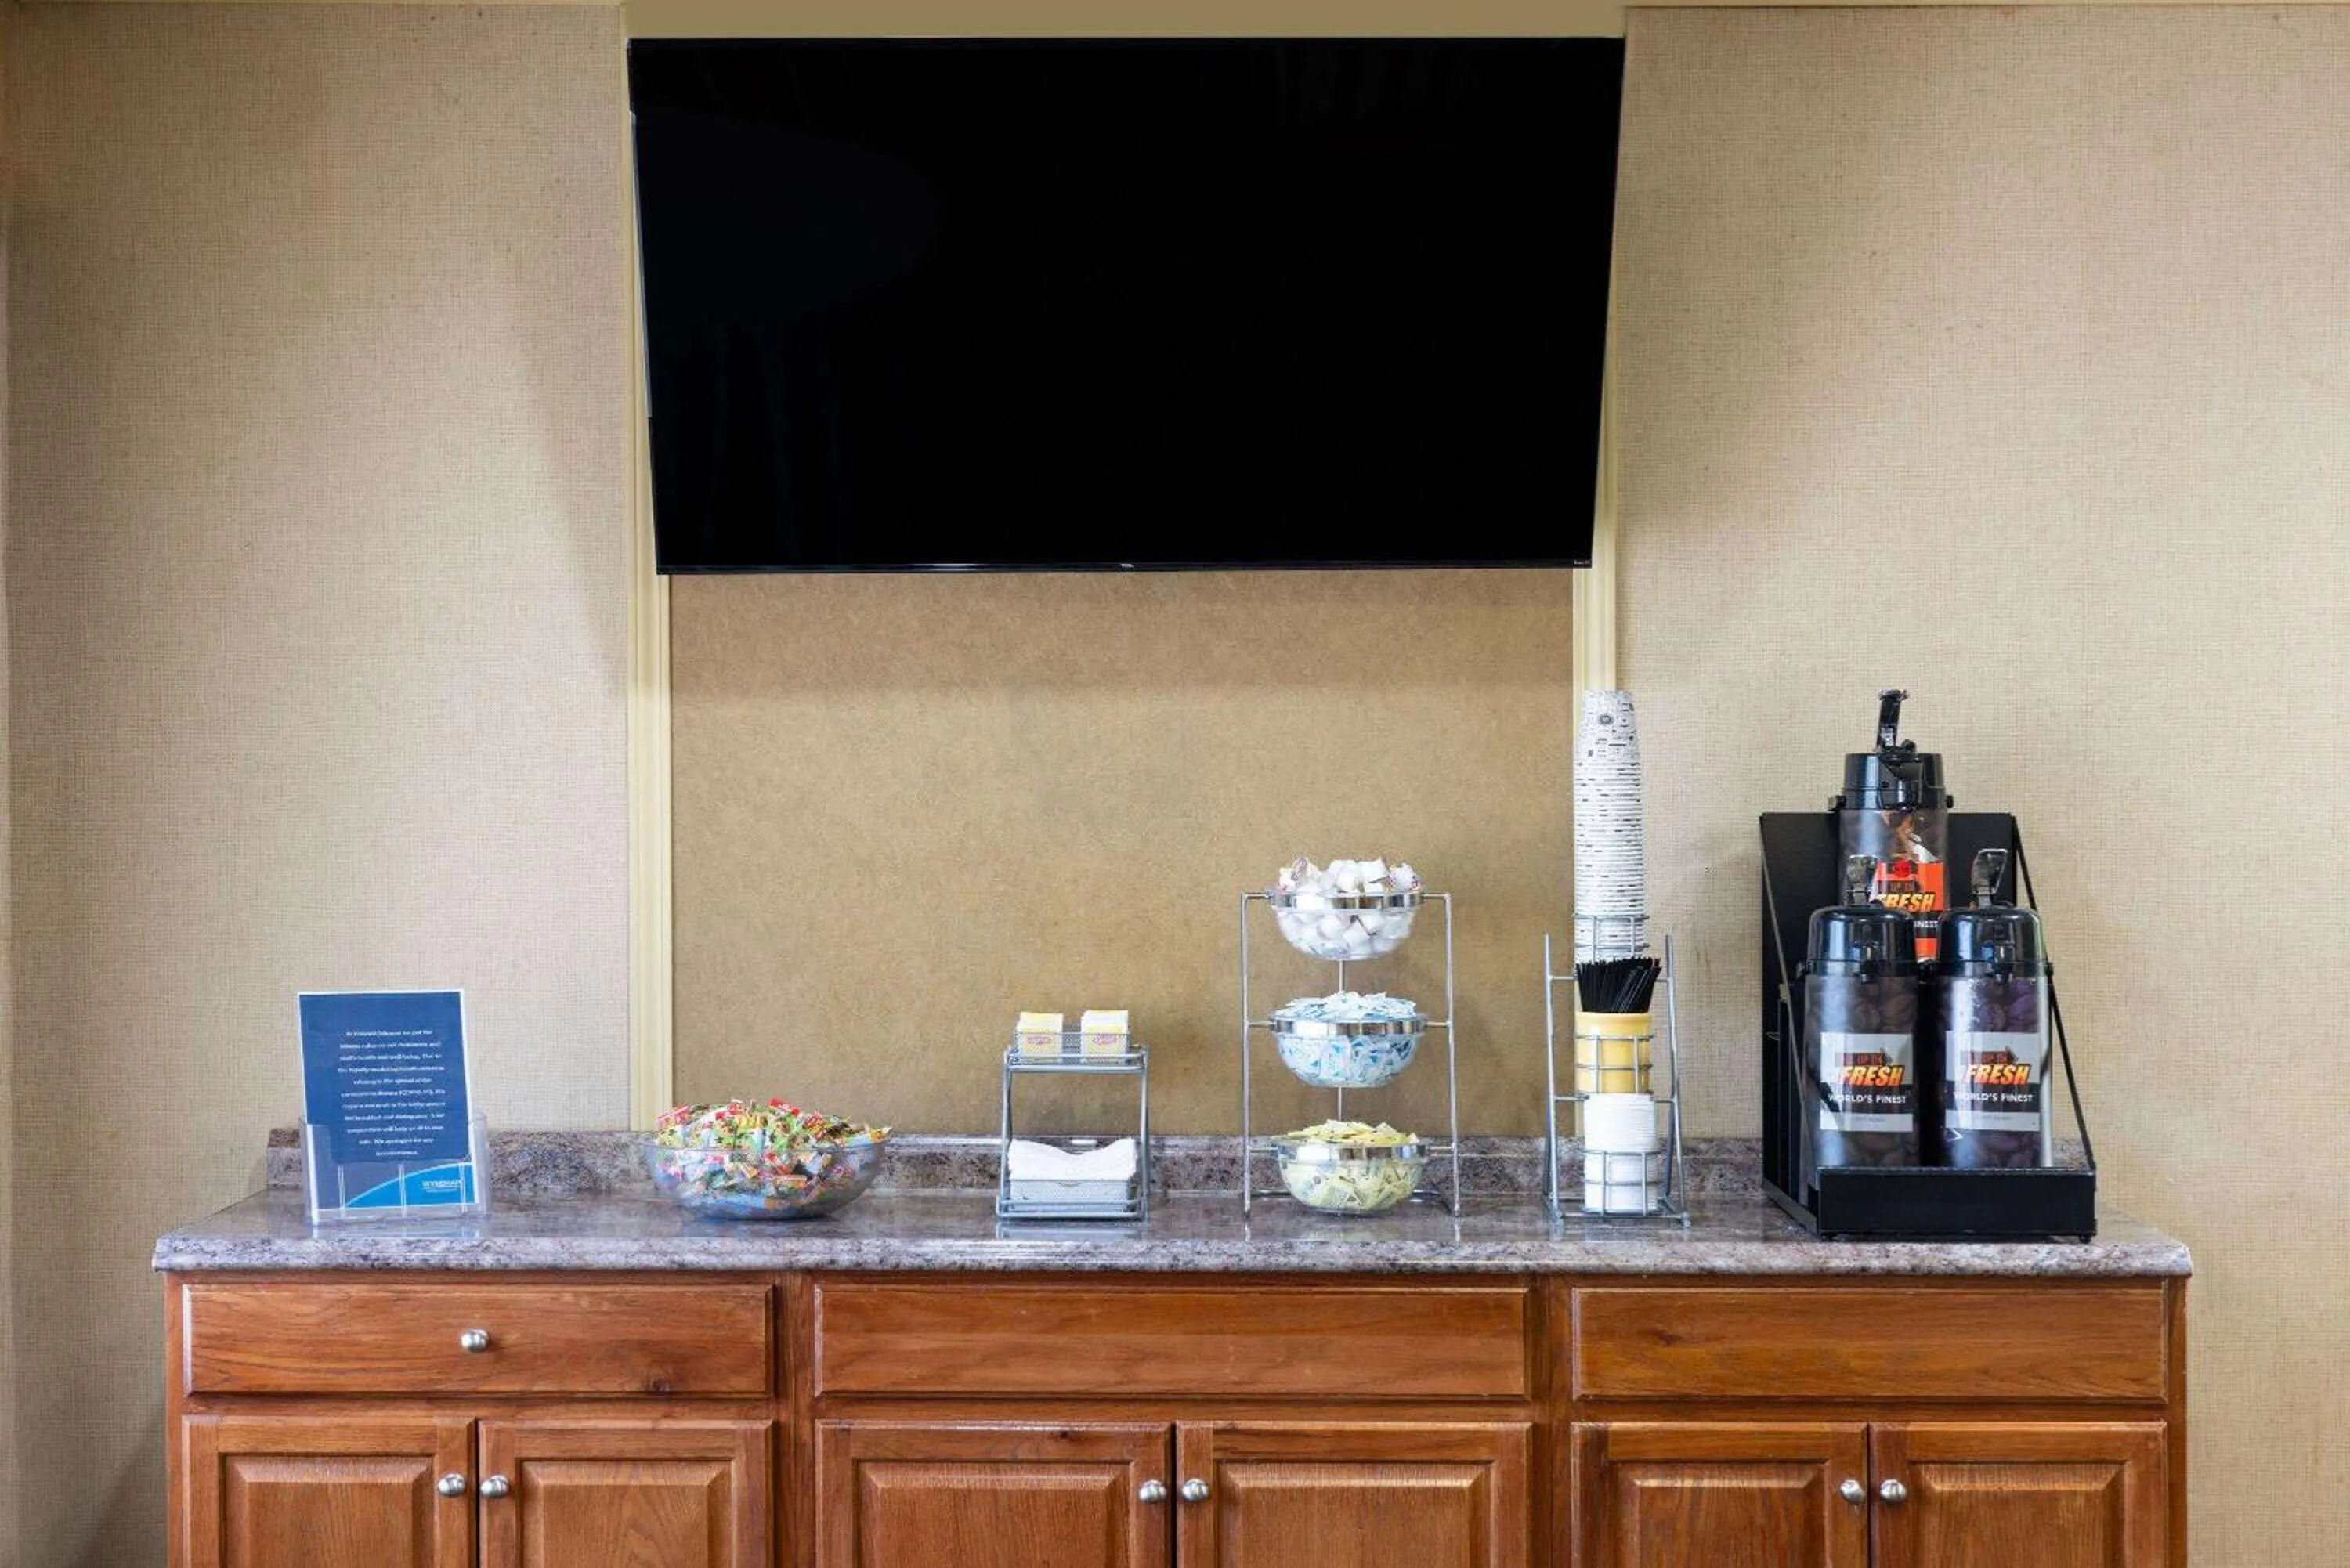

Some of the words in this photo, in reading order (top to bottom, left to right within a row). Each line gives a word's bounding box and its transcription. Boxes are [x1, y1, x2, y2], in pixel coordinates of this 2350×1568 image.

[1838, 1065, 1905, 1087] FRESH
[1965, 1064, 2031, 1086] FRESH
[1876, 1094, 1907, 1104] FINEST
[2001, 1093, 2034, 1103] FINEST
